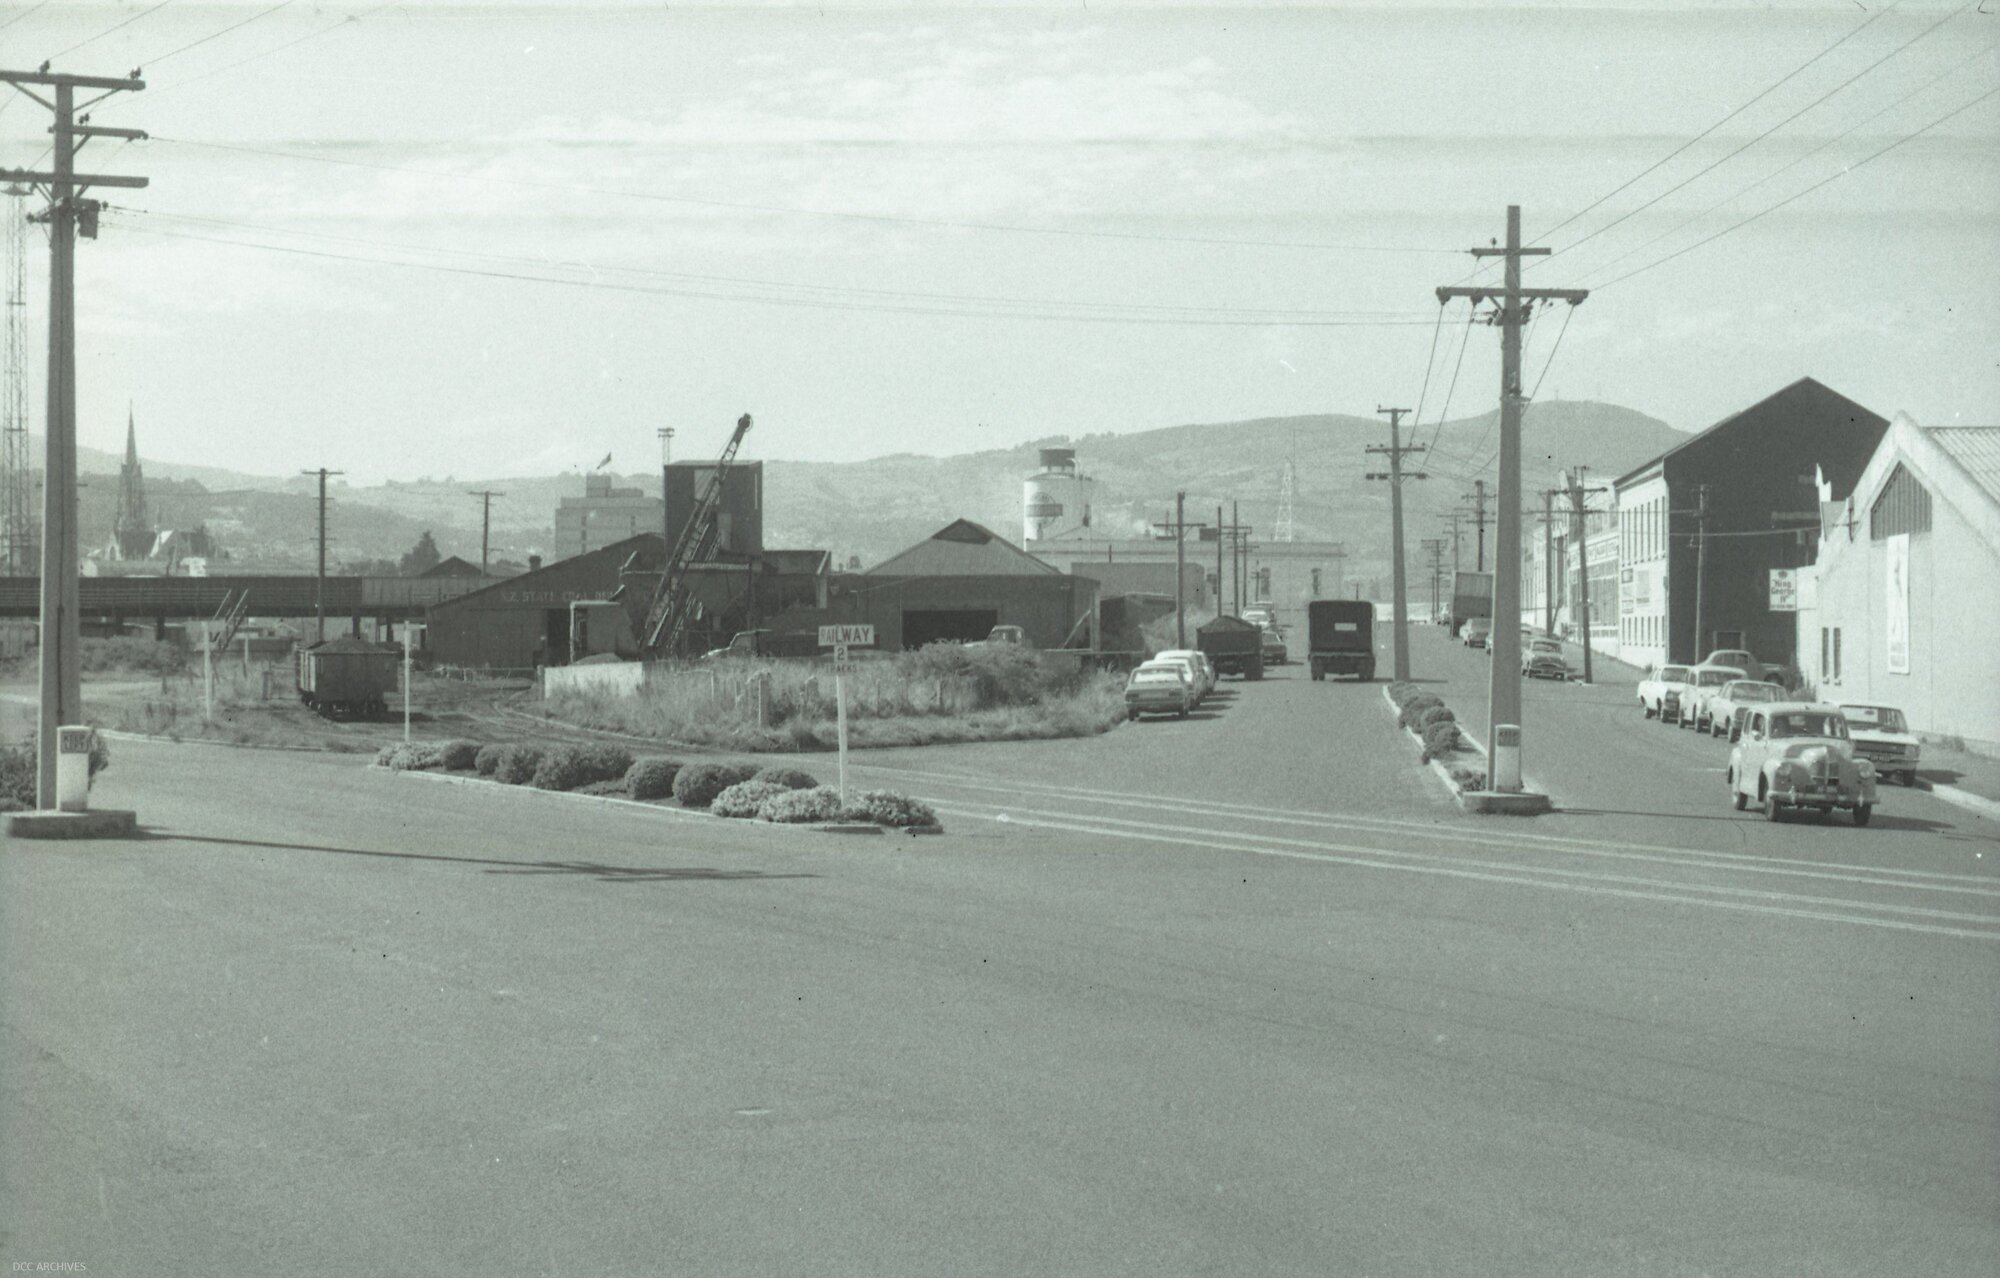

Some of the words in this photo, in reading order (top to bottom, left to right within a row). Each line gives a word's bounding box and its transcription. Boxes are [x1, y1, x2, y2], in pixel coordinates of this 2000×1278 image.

[1771, 587, 1795, 597] George
[822, 626, 870, 642] RAILWAY
[837, 647, 845, 660] 2
[825, 663, 858, 673] TRACKS
